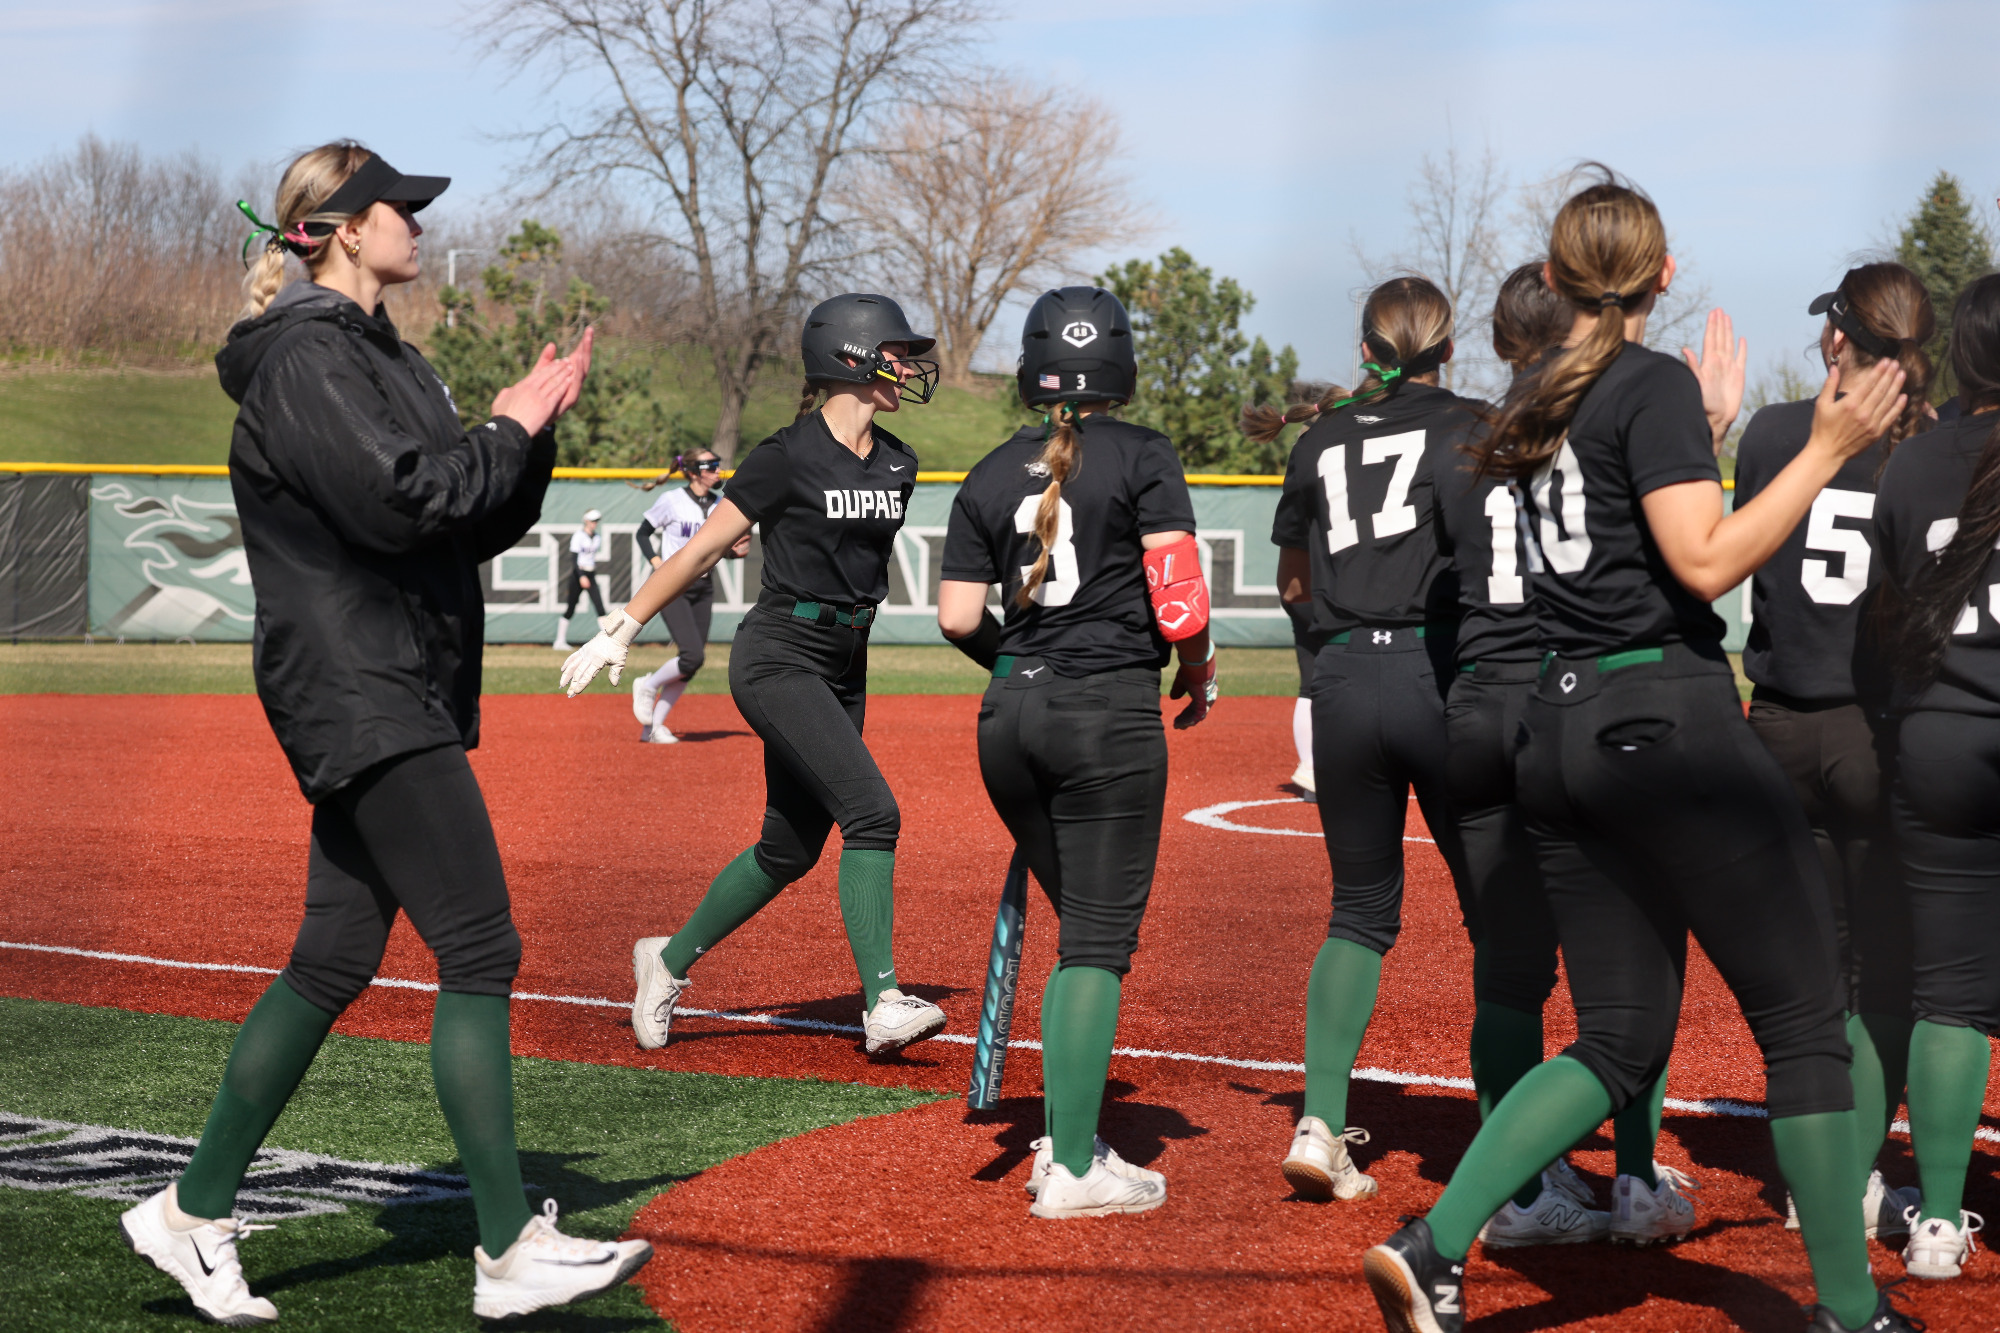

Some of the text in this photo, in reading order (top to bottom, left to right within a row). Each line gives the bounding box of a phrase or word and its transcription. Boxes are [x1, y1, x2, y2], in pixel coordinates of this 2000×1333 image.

[843, 342, 868, 358] VASAK
[1076, 373, 1087, 391] 3
[823, 489, 904, 520] DUPAG
[1316, 429, 1427, 555] 17
[1013, 494, 1081, 607] 3
[1800, 487, 1877, 606] 5
